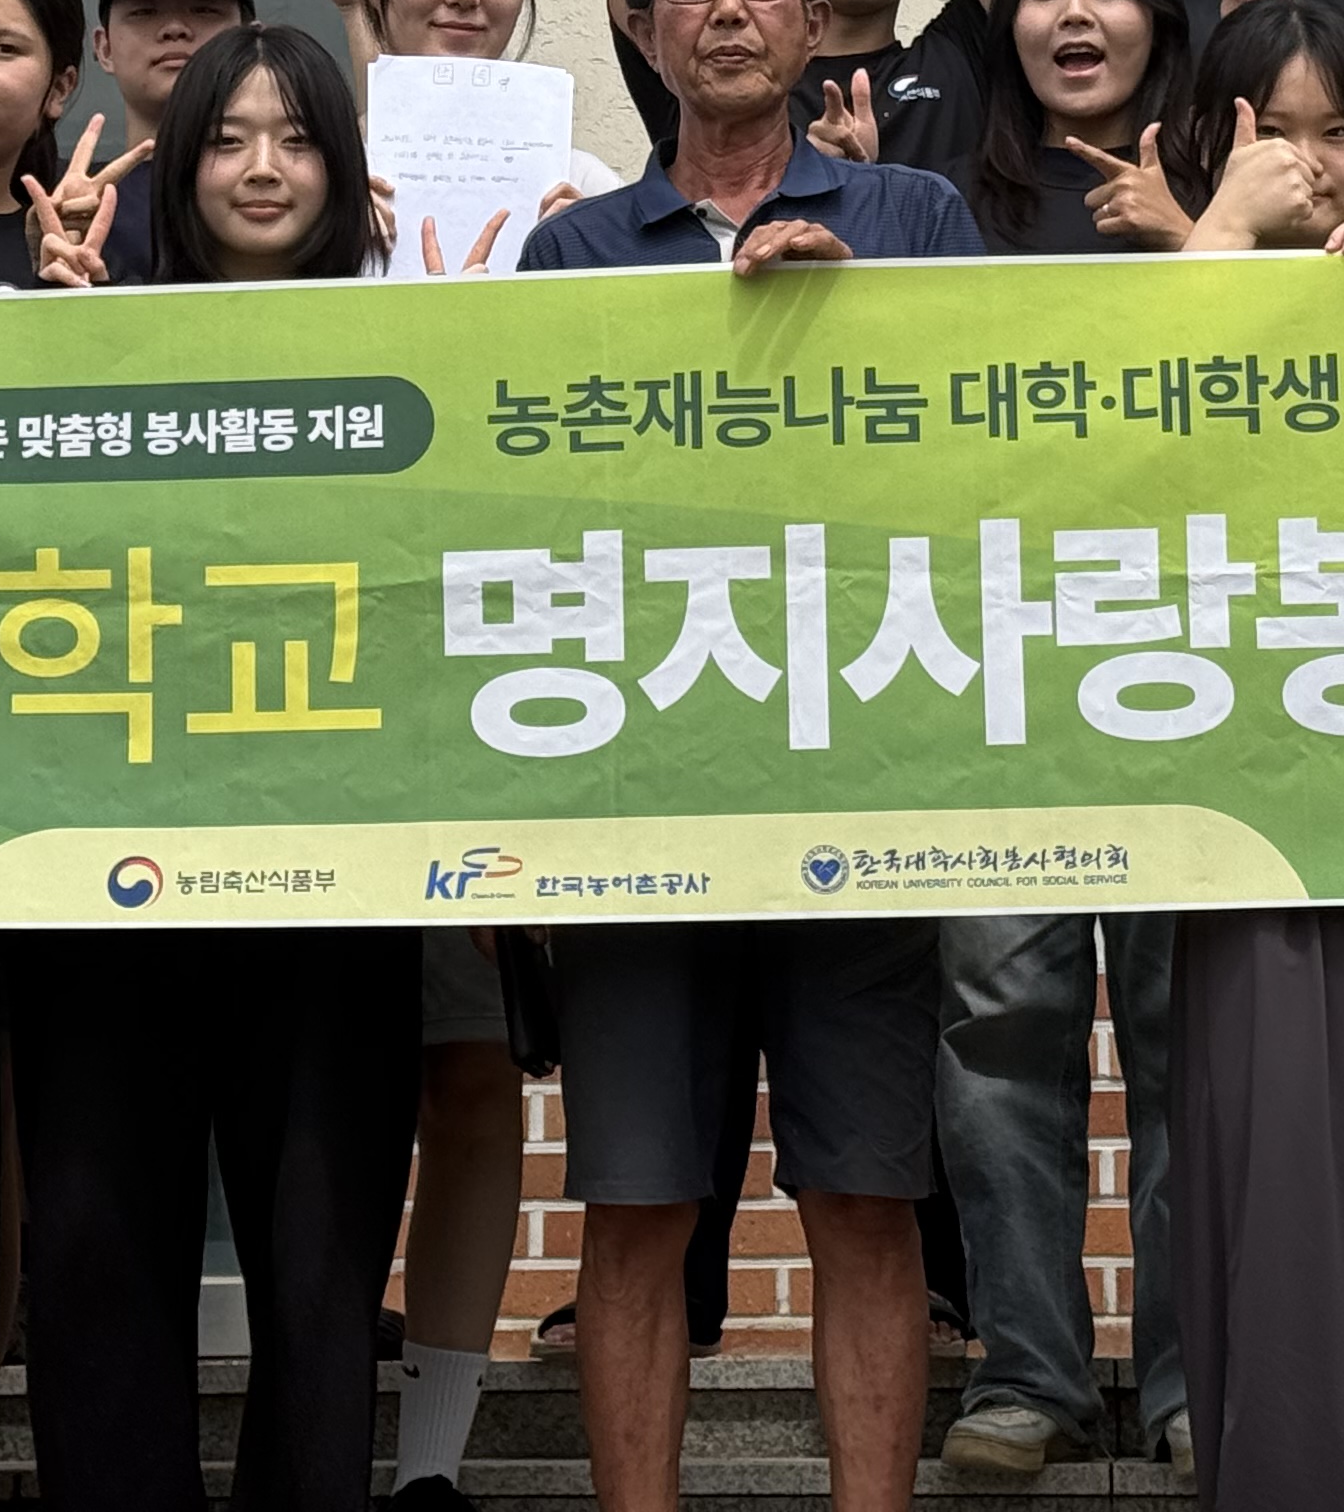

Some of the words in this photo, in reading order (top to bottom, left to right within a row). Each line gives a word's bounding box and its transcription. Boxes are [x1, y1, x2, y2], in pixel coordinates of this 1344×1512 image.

[488, 366, 928, 456] 농촌재능나눔
[950, 352, 1341, 442] 대학·대학생
[18, 411, 133, 458] 맞춤형
[142, 405, 298, 456] 봉사활동
[306, 404, 385, 450] 지원
[852, 843, 1129, 877] 한국대학사회봉사협의회
[175, 869, 337, 895] 농림축산식품부
[535, 872, 711, 897] 한국농어촌공사
[856, 879, 898, 890] KOREAN
[903, 878, 962, 889] UNIVERSITY
[967, 876, 1011, 888] COUNCIL
[1016, 875, 1037, 886] FOR
[1042, 875, 1078, 886] SOCIAL
[1084, 874, 1128, 885] SERVICE
